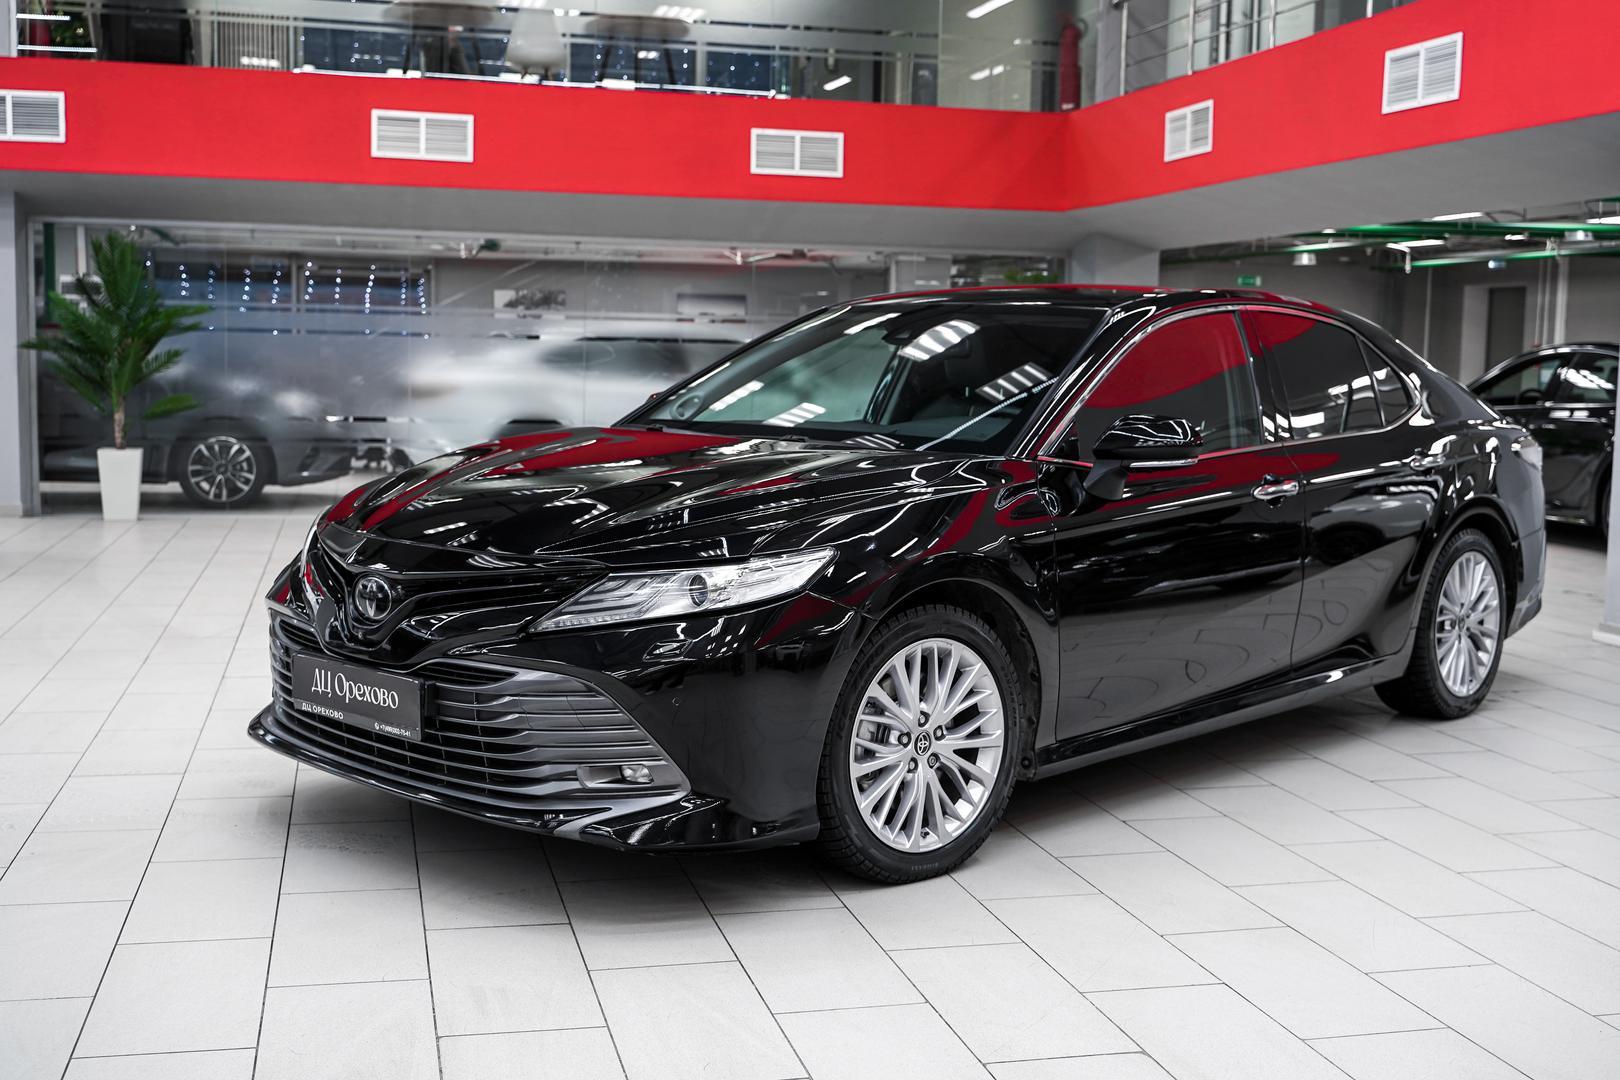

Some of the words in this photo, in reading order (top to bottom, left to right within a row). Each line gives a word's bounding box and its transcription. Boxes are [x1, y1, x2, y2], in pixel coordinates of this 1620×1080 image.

[311, 668, 332, 697] ДЦ
[334, 672, 399, 709] Орехово
[312, 706, 344, 719] ОРЕХОВО
